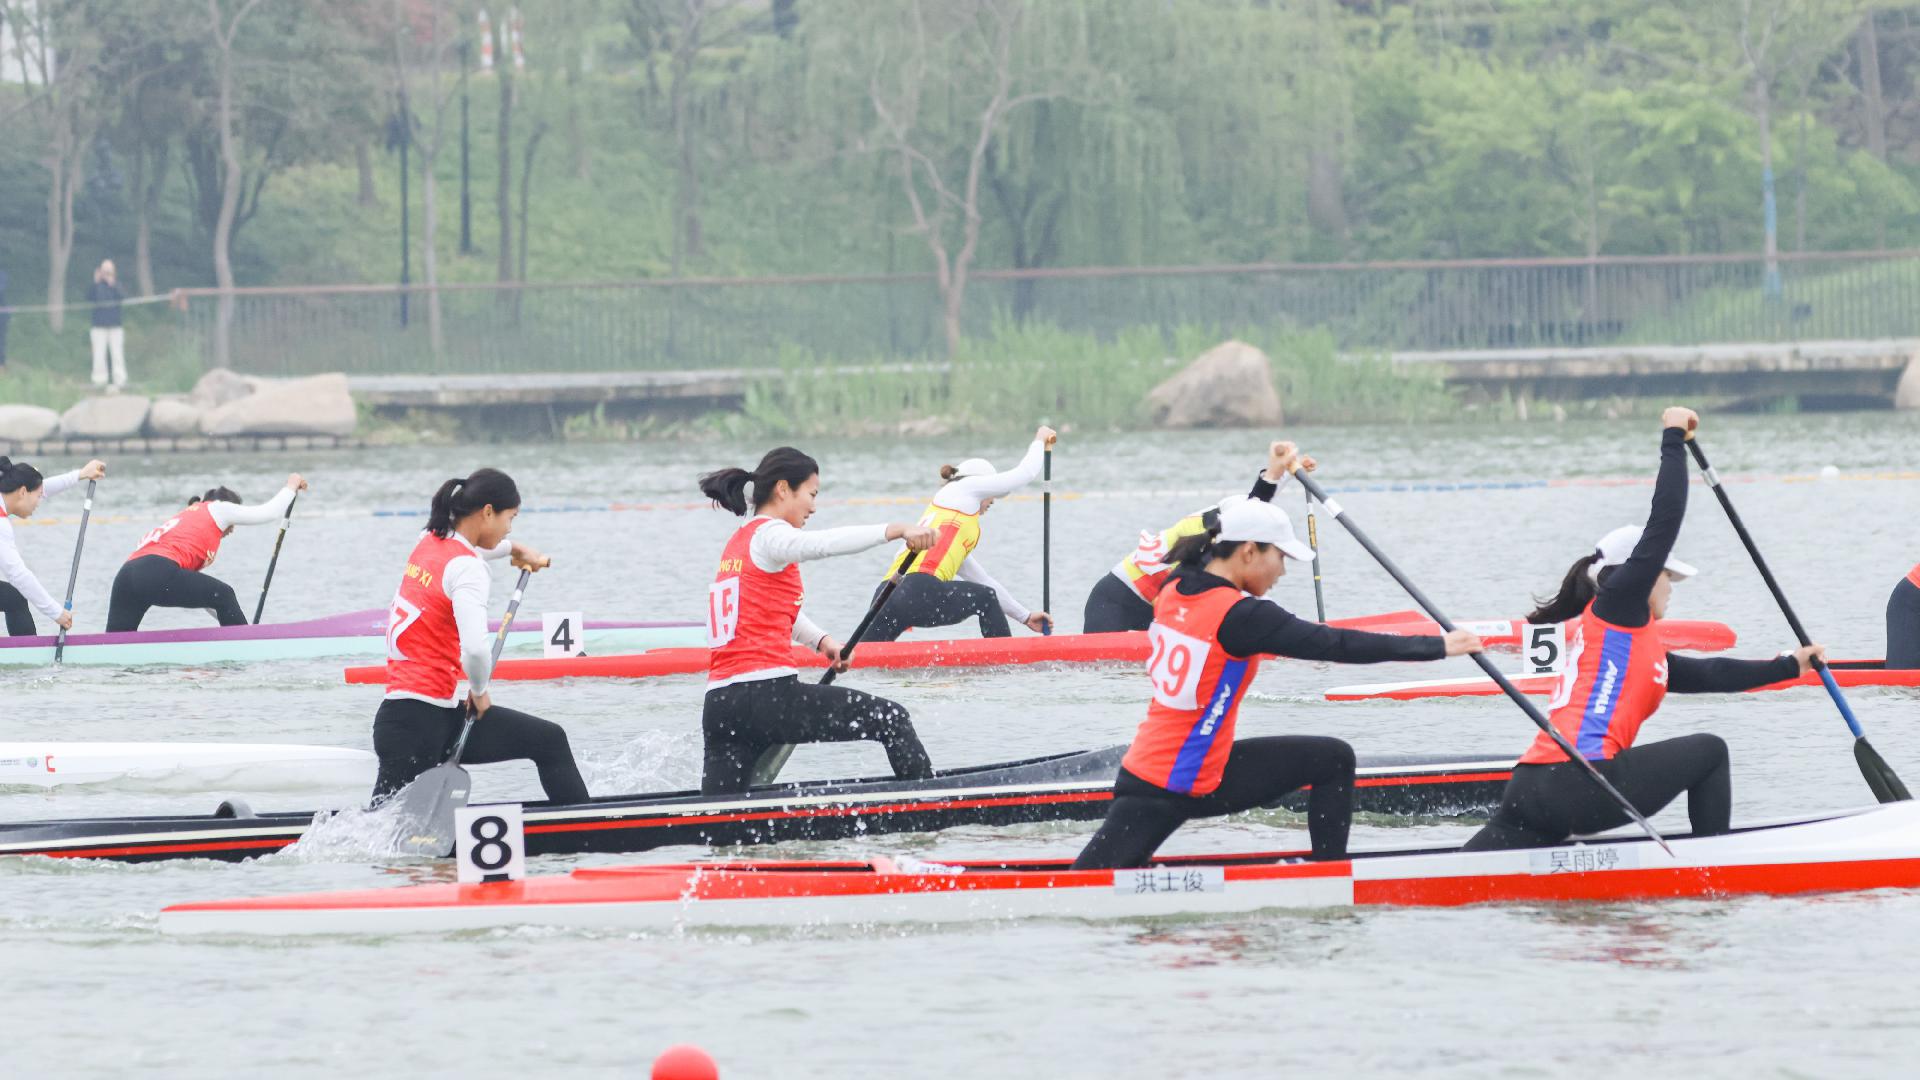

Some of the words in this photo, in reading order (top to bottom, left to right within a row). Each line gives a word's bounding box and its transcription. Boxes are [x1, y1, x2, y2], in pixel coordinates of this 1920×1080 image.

[550, 618, 575, 652] 4
[1530, 627, 1559, 667] 5
[470, 815, 513, 871] 8
[1550, 847, 1620, 874] 吴雨婷
[1135, 869, 1205, 894] 洪士俊
